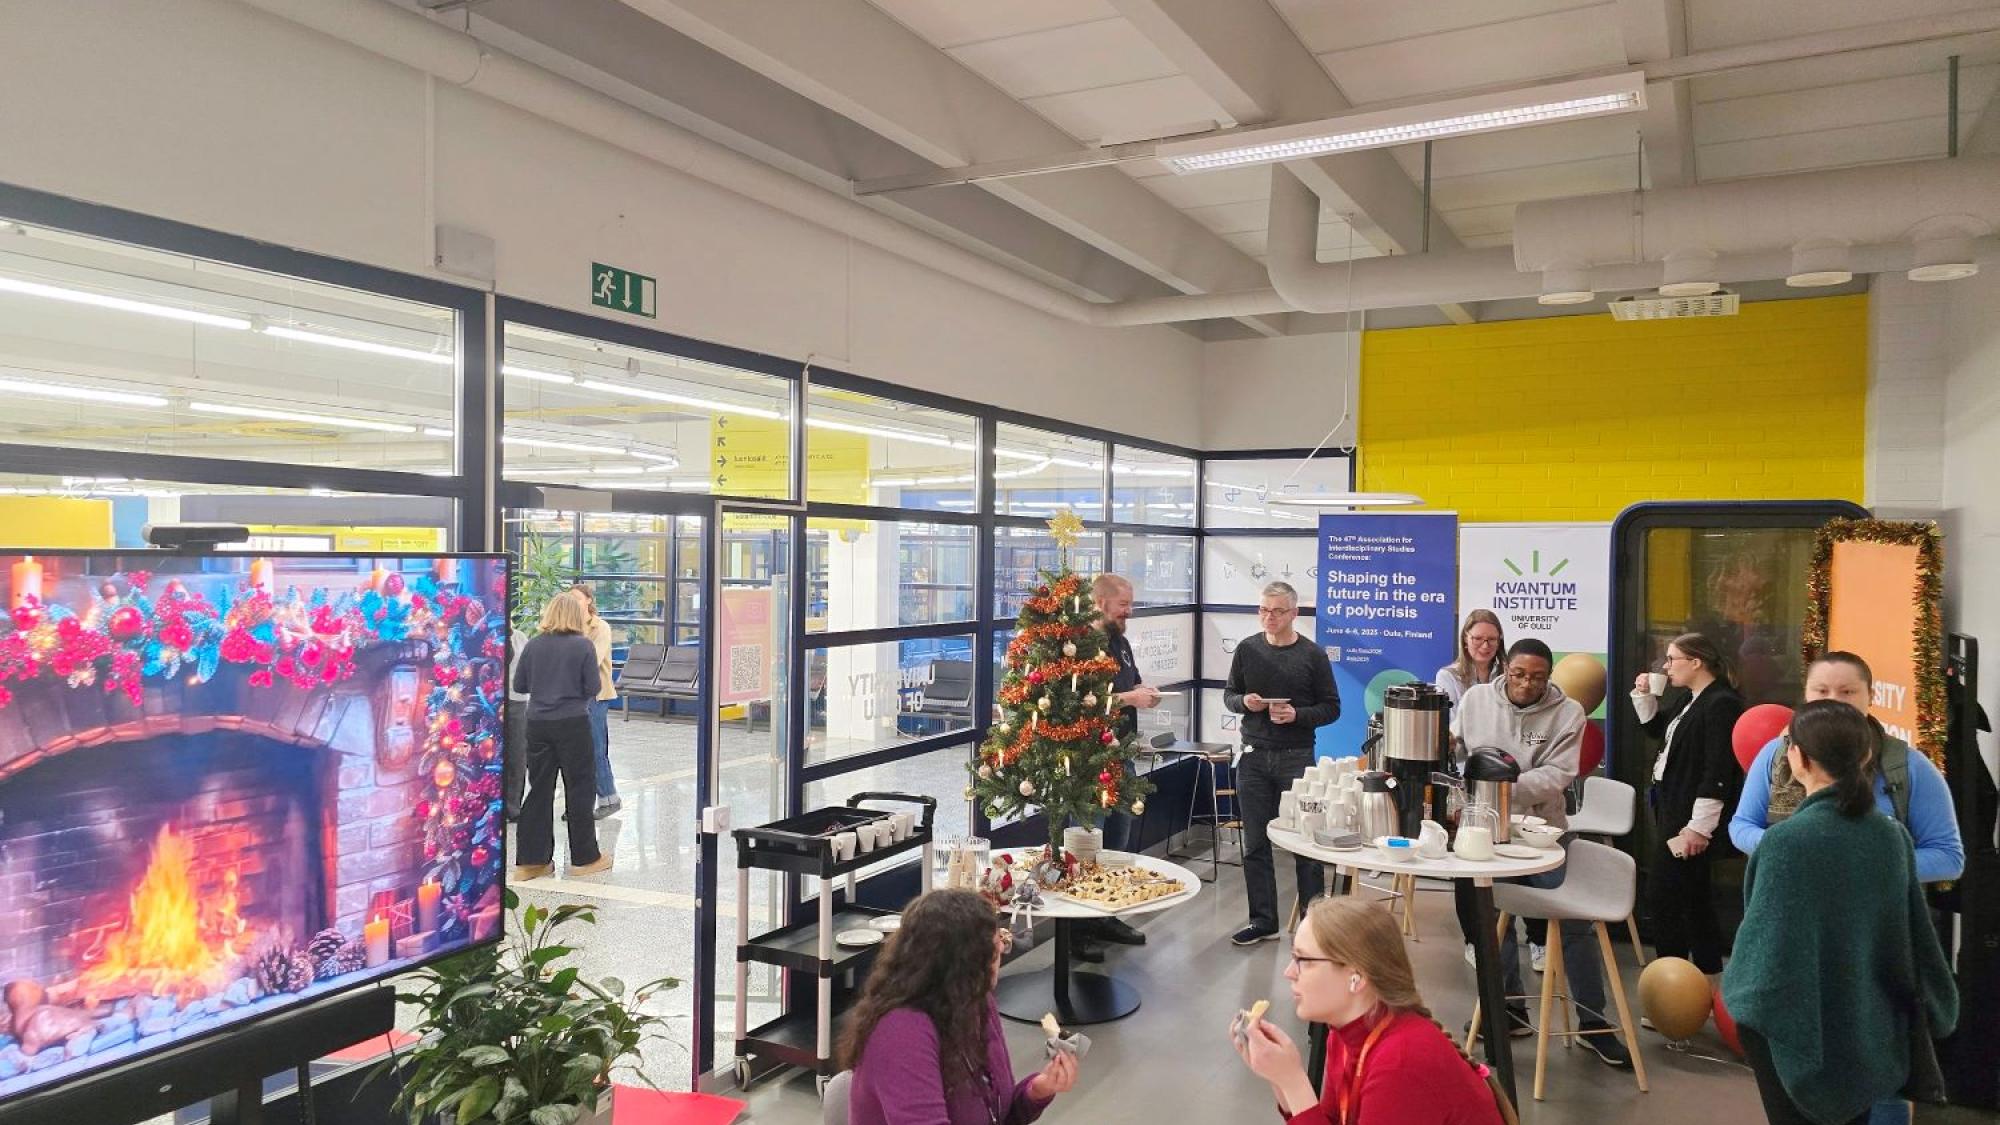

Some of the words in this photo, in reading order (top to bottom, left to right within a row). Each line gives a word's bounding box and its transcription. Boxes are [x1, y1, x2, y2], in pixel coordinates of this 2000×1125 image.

[1358, 535, 1401, 544] Association
[1402, 536, 1413, 544] for
[1328, 544, 1387, 553] Interdisciplinary
[1387, 545, 1416, 553] Studies
[1328, 570, 1388, 587] Shaping
[1392, 572, 1416, 585] the
[1327, 586, 1371, 600] future
[1374, 588, 1388, 601] in
[1393, 589, 1417, 602] the
[1420, 592, 1445, 603] era
[1495, 582, 1576, 595] KVANTUM
[1493, 596, 1578, 610] INSTITUTE
[1327, 603, 1342, 615] of
[1345, 604, 1418, 619] polycrisis
[1404, 630, 1433, 640] Finland
